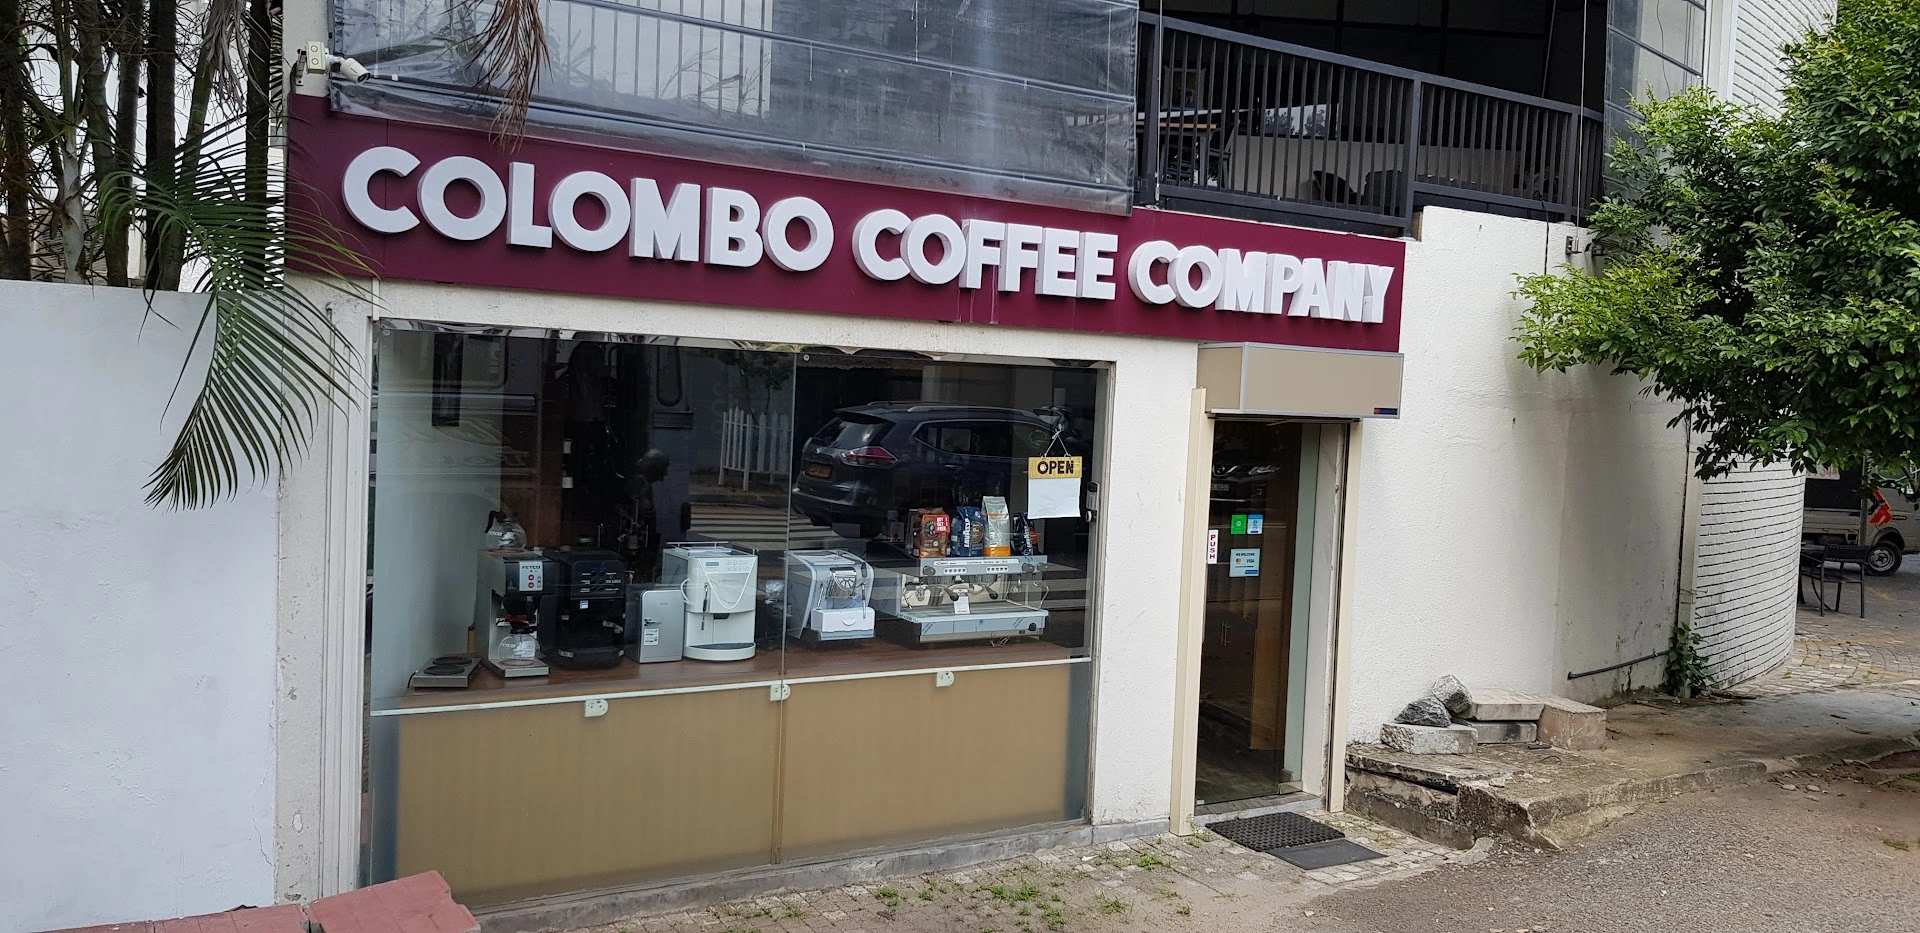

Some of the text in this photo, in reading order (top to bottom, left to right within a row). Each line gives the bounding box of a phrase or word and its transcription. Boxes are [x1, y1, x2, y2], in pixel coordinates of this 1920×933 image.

[342, 146, 1394, 324] COLOMBO COFFEE COMPANY
[1037, 460, 1074, 475] OPEN
